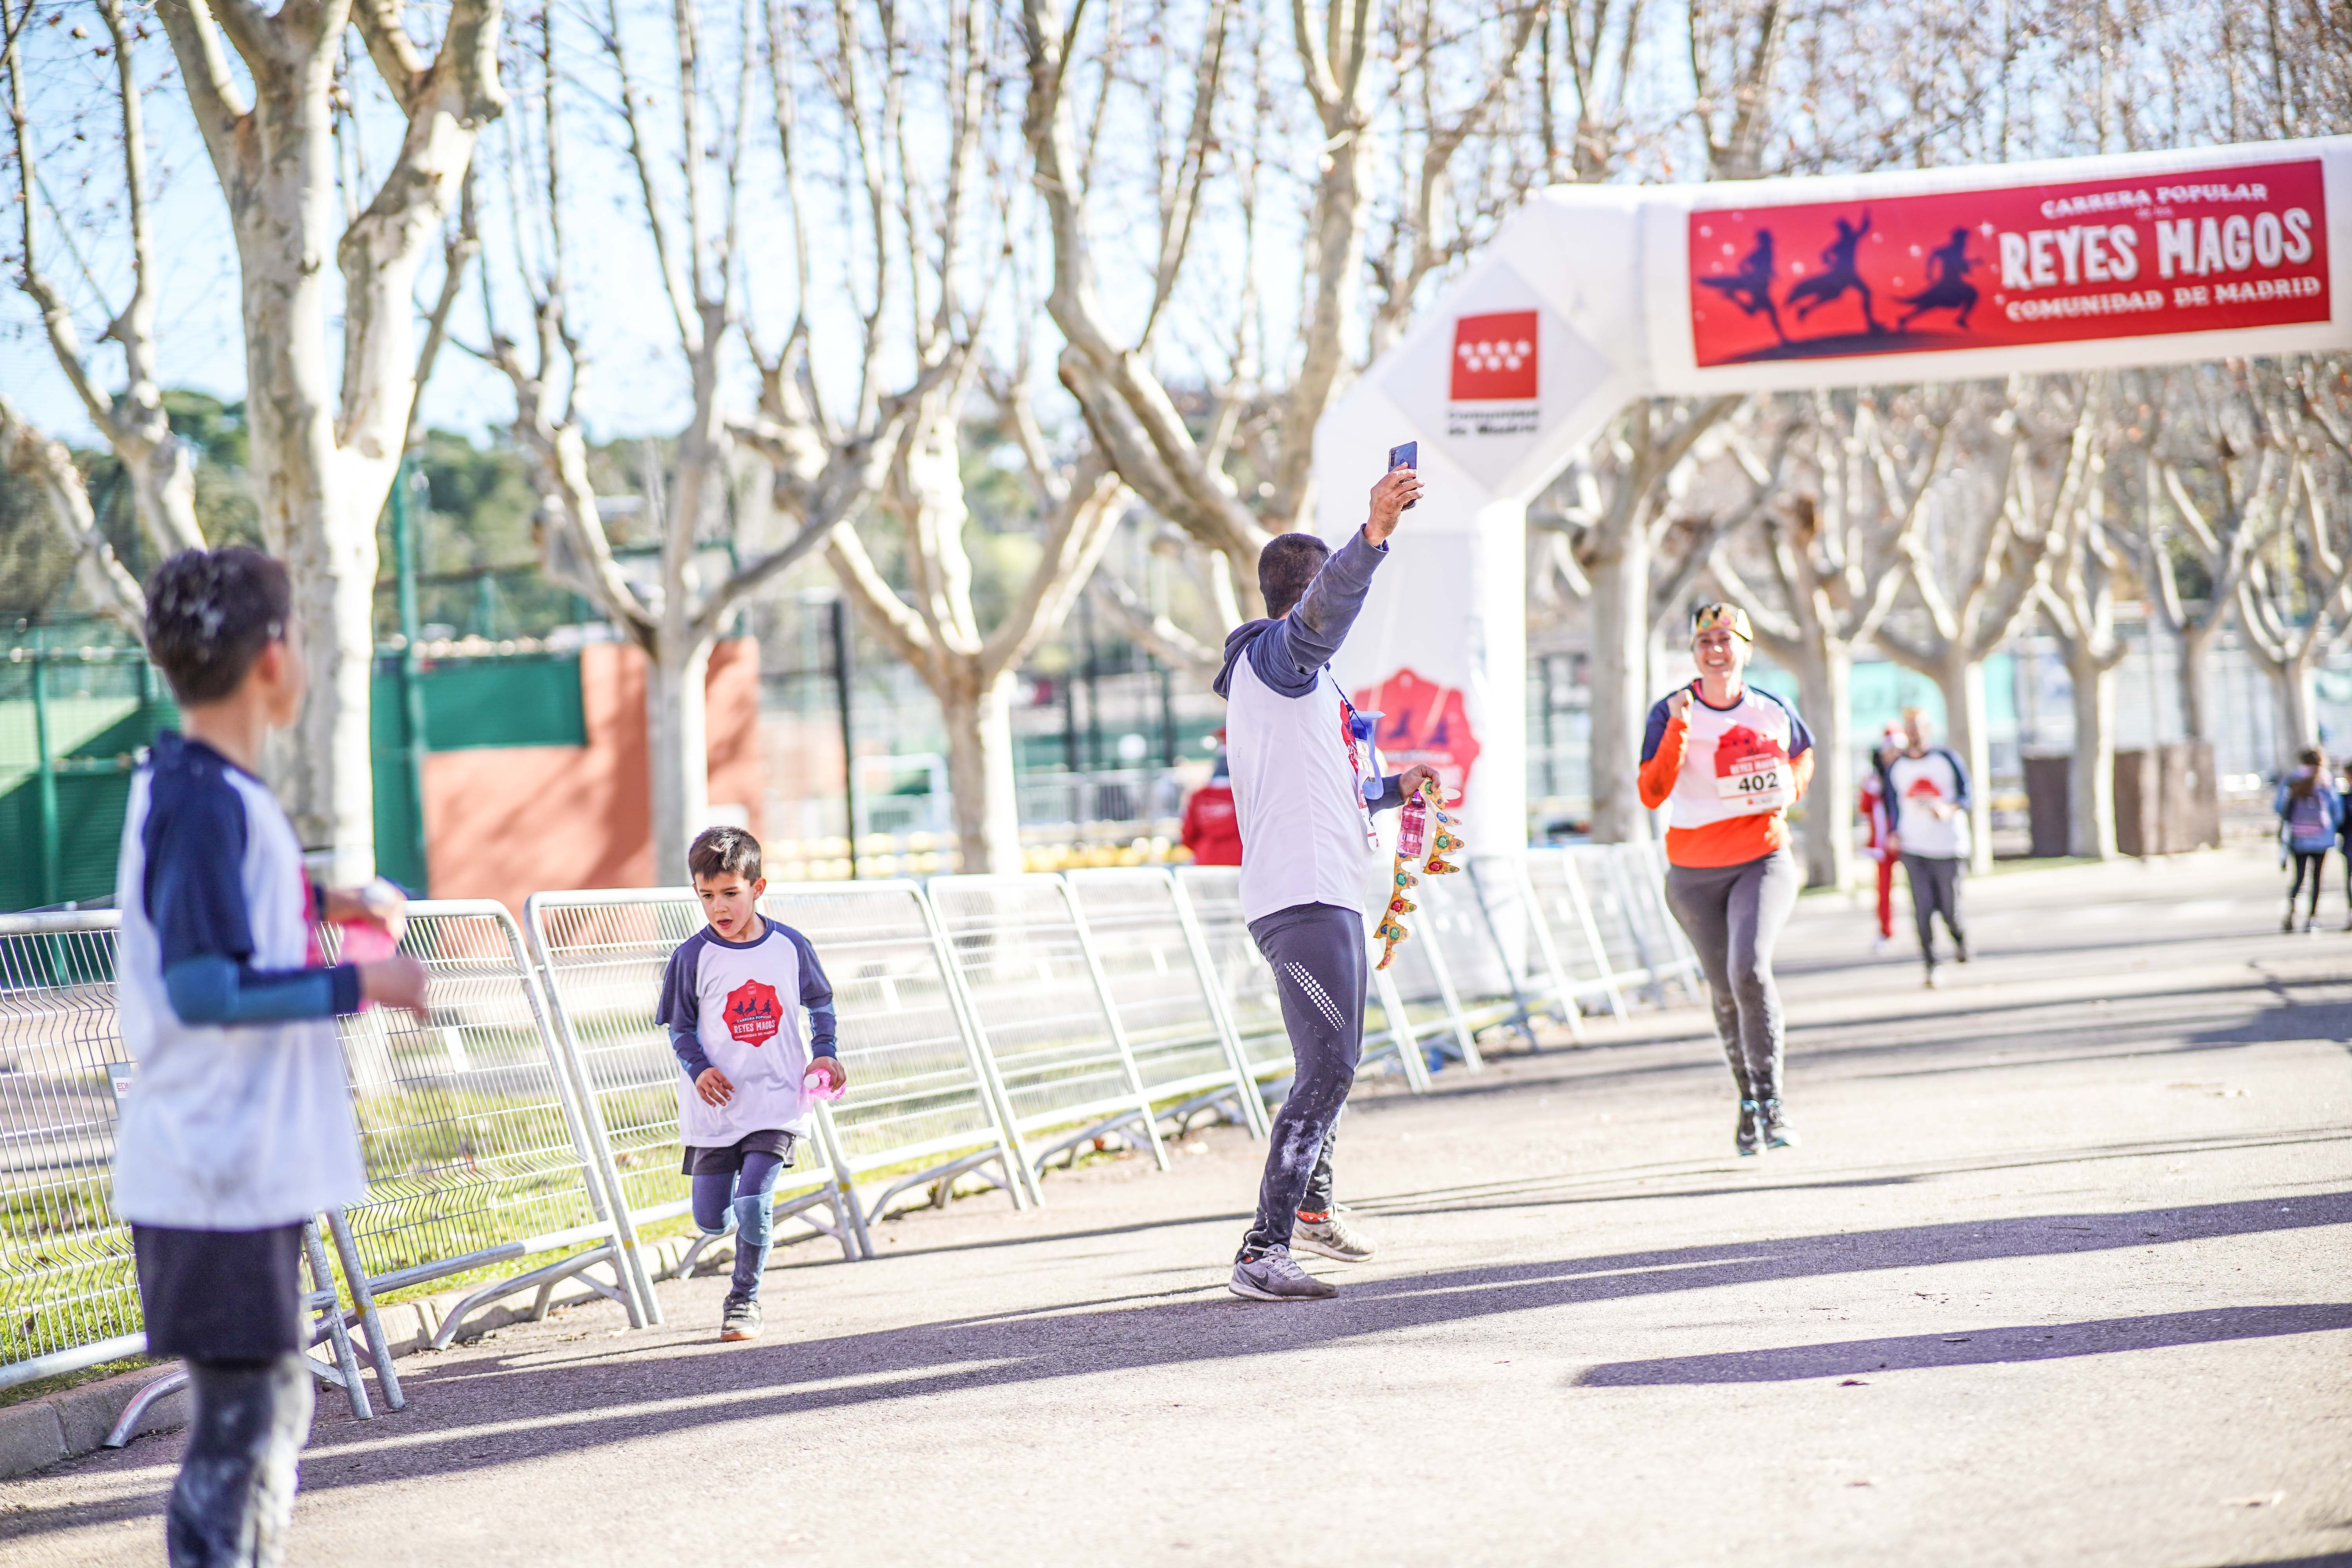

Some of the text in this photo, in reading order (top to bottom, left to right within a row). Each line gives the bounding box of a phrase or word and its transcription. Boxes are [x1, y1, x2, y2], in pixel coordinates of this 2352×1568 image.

[2041, 183, 2268, 220] CARRERA POPULAR
[1999, 207, 2314, 290] REYES MAGOS
[2006, 276, 2321, 322] COMUNIDAD DE MADRID
[1738, 772, 1778, 791] 402
[734, 1020, 775, 1034] REYES MAGOS
